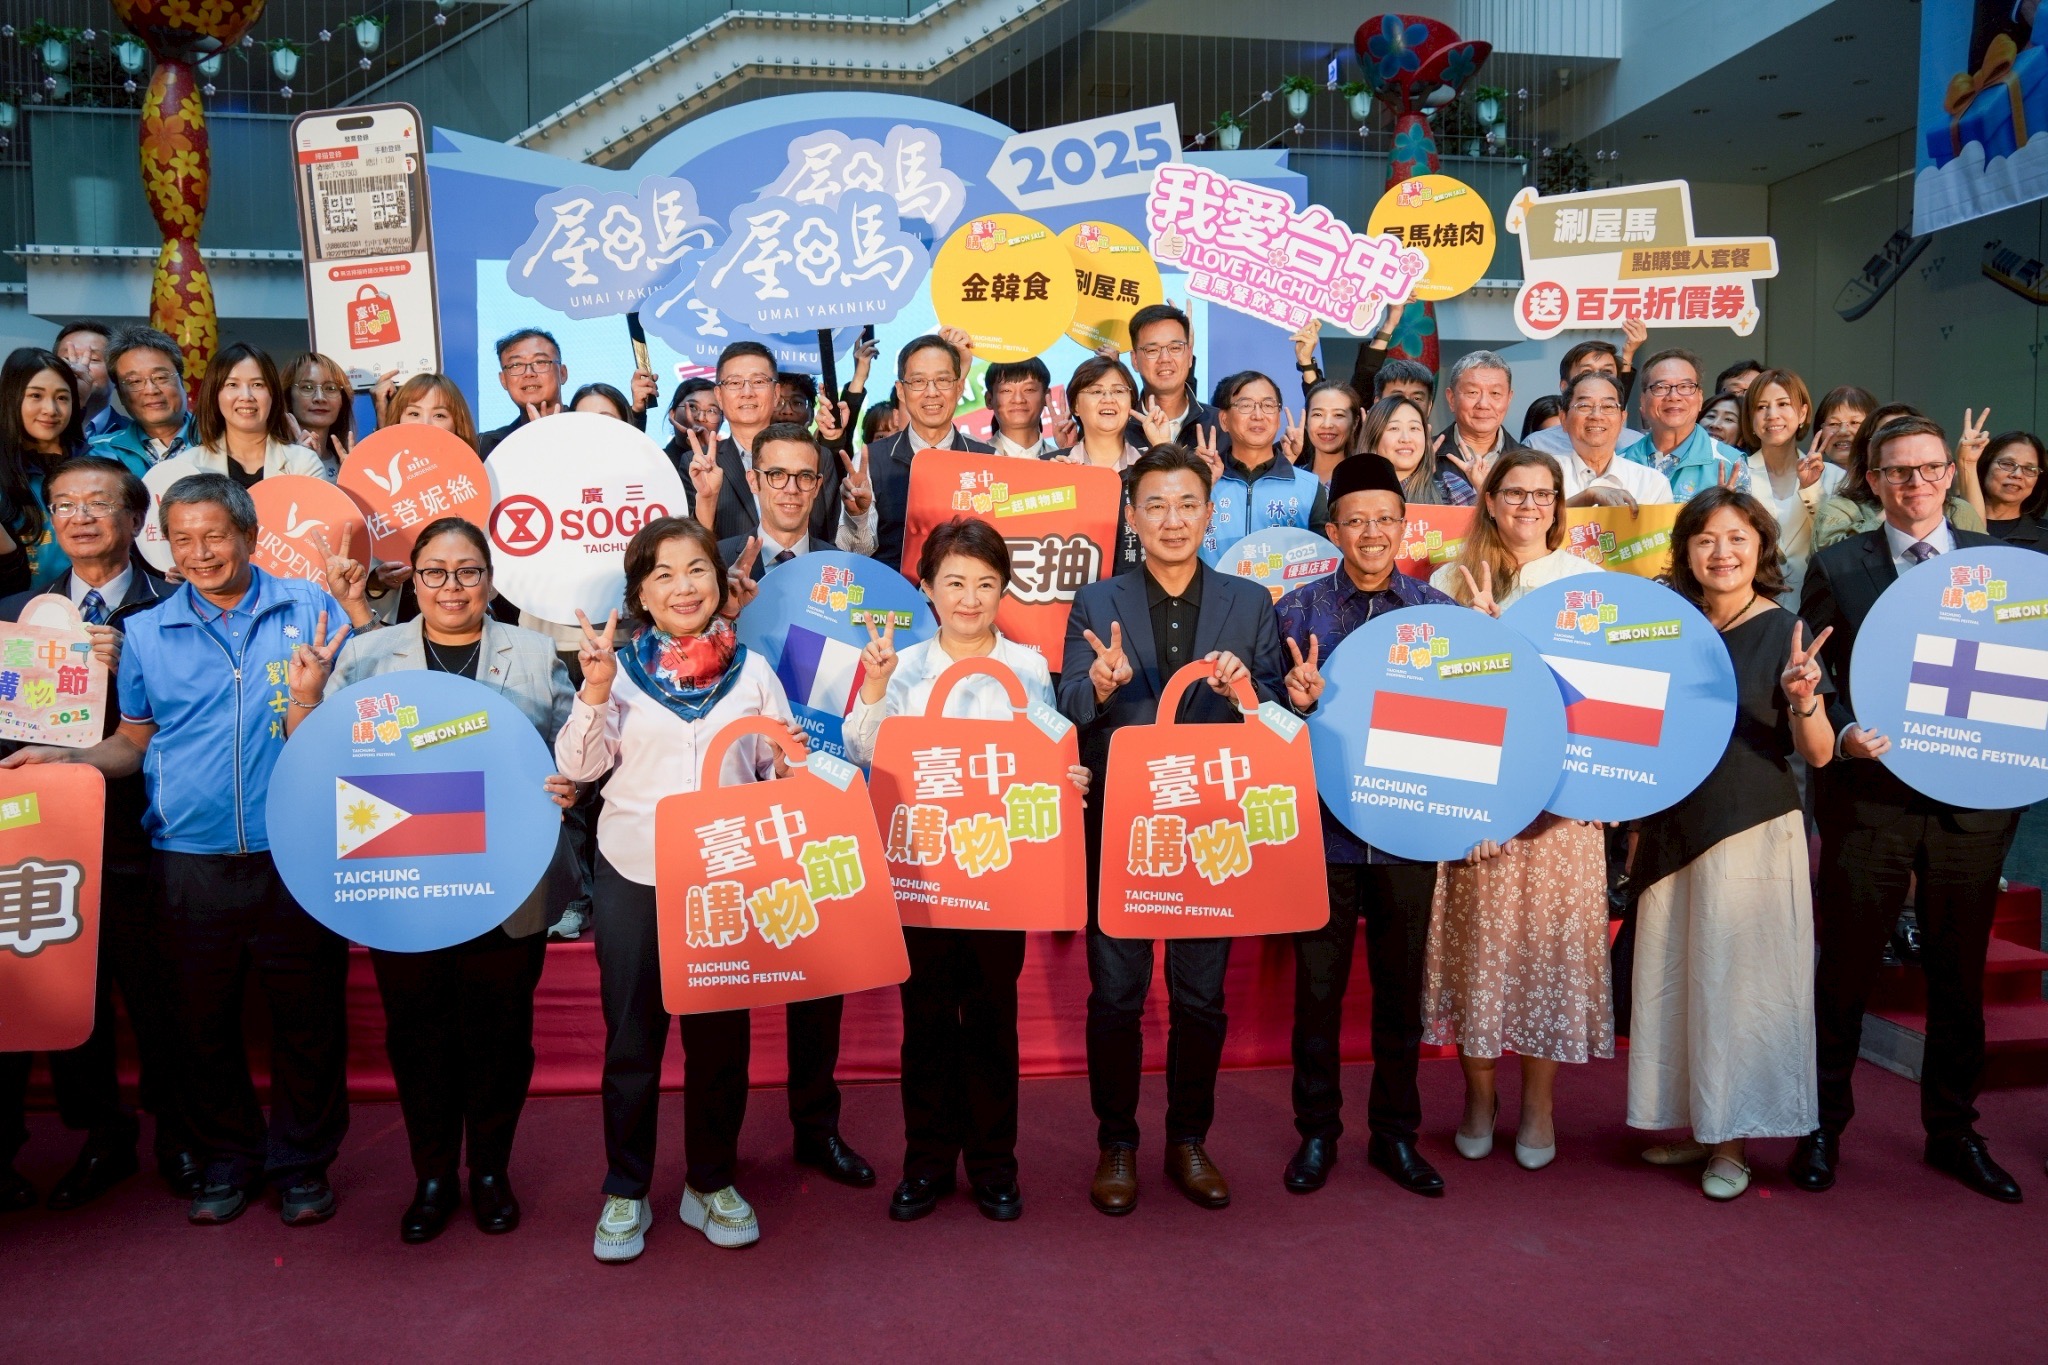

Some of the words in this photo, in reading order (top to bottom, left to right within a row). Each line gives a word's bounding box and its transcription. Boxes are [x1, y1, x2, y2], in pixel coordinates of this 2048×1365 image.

[375, 144, 402, 154] 手動登錄
[1009, 121, 1172, 196] 2025
[1397, 188, 1432, 208] 購物節
[1401, 181, 1423, 194] 臺中
[971, 220, 996, 236] 臺中
[1080, 223, 1102, 237] 臺中
[1153, 169, 1410, 299] 我愛台中
[1553, 207, 1658, 243] 涮屋馬
[711, 201, 914, 300] 屋馬
[965, 229, 1007, 252] 購物節
[1074, 234, 1110, 253] 購物節
[1631, 247, 1751, 272] 點購雙人套餐
[961, 271, 1051, 302] 金韓食
[1184, 242, 1191, 263] I
[1192, 244, 1250, 278] LOVE
[1248, 262, 1350, 318] TAICHUNG
[355, 302, 380, 320] 臺中
[570, 291, 611, 308] UMAI
[758, 307, 800, 321] UMAI
[807, 299, 887, 316] YAKINIKU
[1191, 273, 1311, 326] 屋馬餐飲集團
[1528, 287, 1562, 322] 送
[1575, 284, 1745, 321] 百元折價券
[354, 309, 392, 335] 購物節
[1073, 321, 1100, 334] TAICHUNG
[971, 334, 1003, 343] TAICHUNG
[972, 342, 1002, 350] HOPPING
[1003, 344, 1030, 352] FESTIVAL
[1072, 327, 1098, 340] SHOPPING
[1098, 336, 1121, 348] FESTIVAL
[959, 469, 994, 490] 臺中
[581, 484, 646, 504] 廣三
[952, 482, 1009, 514] 購物節
[367, 474, 478, 541] 佐登妮絲
[1219, 497, 1232, 523] 特助
[1569, 522, 1601, 545] 臺中
[583, 542, 629, 554] TAICHU
[1242, 542, 1272, 560] 臺中
[1288, 546, 1315, 560] 2025
[821, 565, 855, 588] 臺中
[1236, 553, 1283, 580] 購物節
[1287, 560, 1331, 578] 優惠店家
[1950, 564, 1992, 587] 臺中
[809, 583, 865, 612] 購物節
[1564, 590, 1603, 610] 臺中
[1941, 579, 2008, 613] 購物節
[893, 615, 910, 626] ALE
[1555, 603, 1618, 635] 購物節
[1652, 624, 1679, 637] SALE
[1396, 623, 1435, 644] 臺中
[3, 639, 67, 669] 臺中
[1388, 637, 1450, 669] 購物節
[1483, 657, 1510, 671] SALE
[49, 708, 90, 726] 2025
[356, 693, 400, 720] 臺中
[352, 705, 419, 745] 購物節
[459, 716, 487, 733] SALE
[1033, 706, 1066, 734] SALE
[1264, 707, 1297, 734] SALE
[1902, 721, 1982, 744] TAICHUNG
[1899, 737, 1978, 760] SHOPPING
[1981, 748, 2048, 771] FESTIVAL
[814, 755, 851, 782] SALE
[911, 743, 1016, 800] 臺中
[1146, 747, 1251, 810] 臺中
[1591, 763, 1658, 786] FESTIVAL
[1353, 774, 1428, 797] TAICHUNG
[1351, 790, 1424, 812] SHOPPING
[1427, 801, 1492, 823] FESTIVAL
[694, 804, 807, 878] 臺中
[885, 783, 1061, 878] 購物節
[1126, 784, 1299, 886] 購物節
[334, 868, 420, 885] TAICHUNG
[889, 876, 941, 892] AICHUNG
[334, 886, 420, 903] SHOPPING
[423, 882, 495, 898] FESTIVAL
[686, 835, 866, 949] 購物節
[893, 890, 938, 905] OPPING
[940, 896, 991, 911] FESTIVAL
[1125, 890, 1184, 902] TAICHUNG
[1124, 903, 1182, 915] SHOPPING
[1185, 905, 1235, 918] FESTIVAL
[687, 960, 750, 974] TAICHUNG
[687, 974, 750, 988] SHOPPING
[752, 970, 806, 984] FESTIVAL
